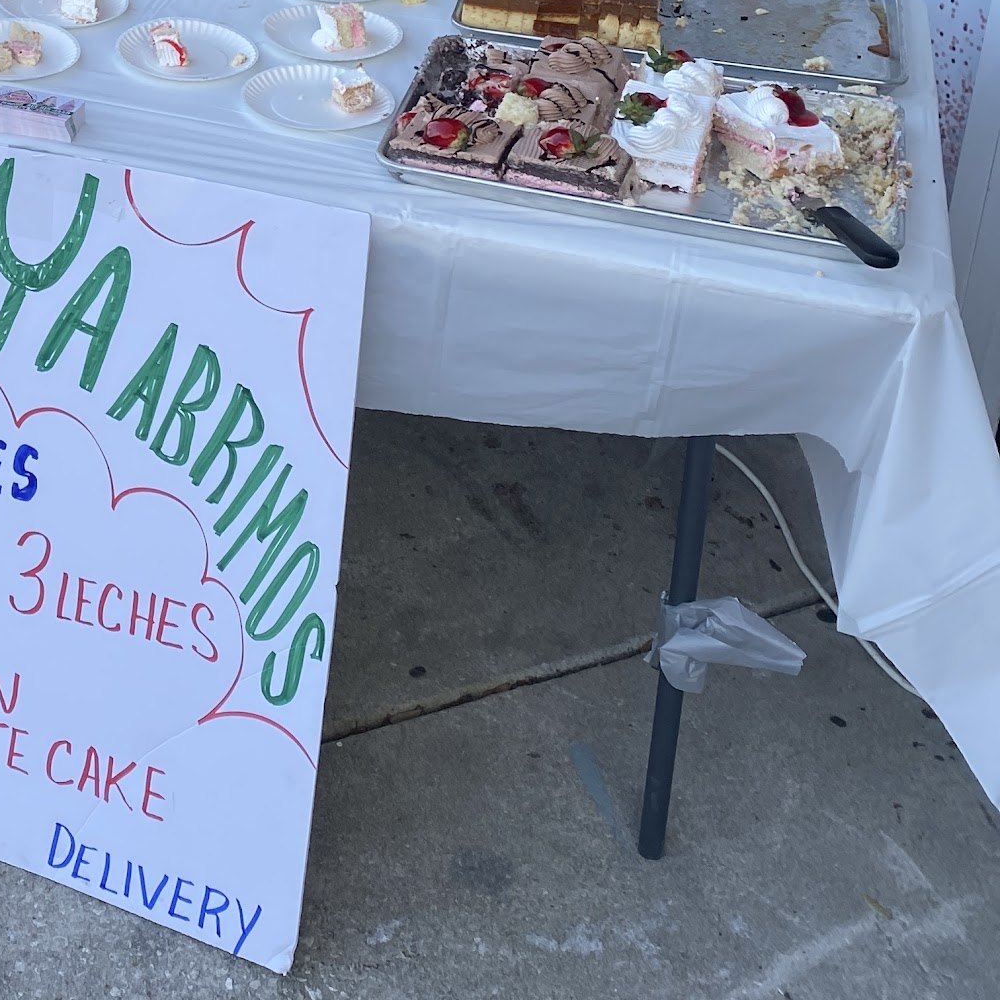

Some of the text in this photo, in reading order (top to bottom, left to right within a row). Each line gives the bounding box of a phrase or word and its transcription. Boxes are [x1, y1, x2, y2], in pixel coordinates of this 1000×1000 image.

[105, 323, 327, 706] ABRIMOS
[8, 531, 52, 615] 3
[56, 572, 219, 662] LECHES
[46, 740, 167, 822] CAKE
[47, 822, 263, 955] DELIVERY
